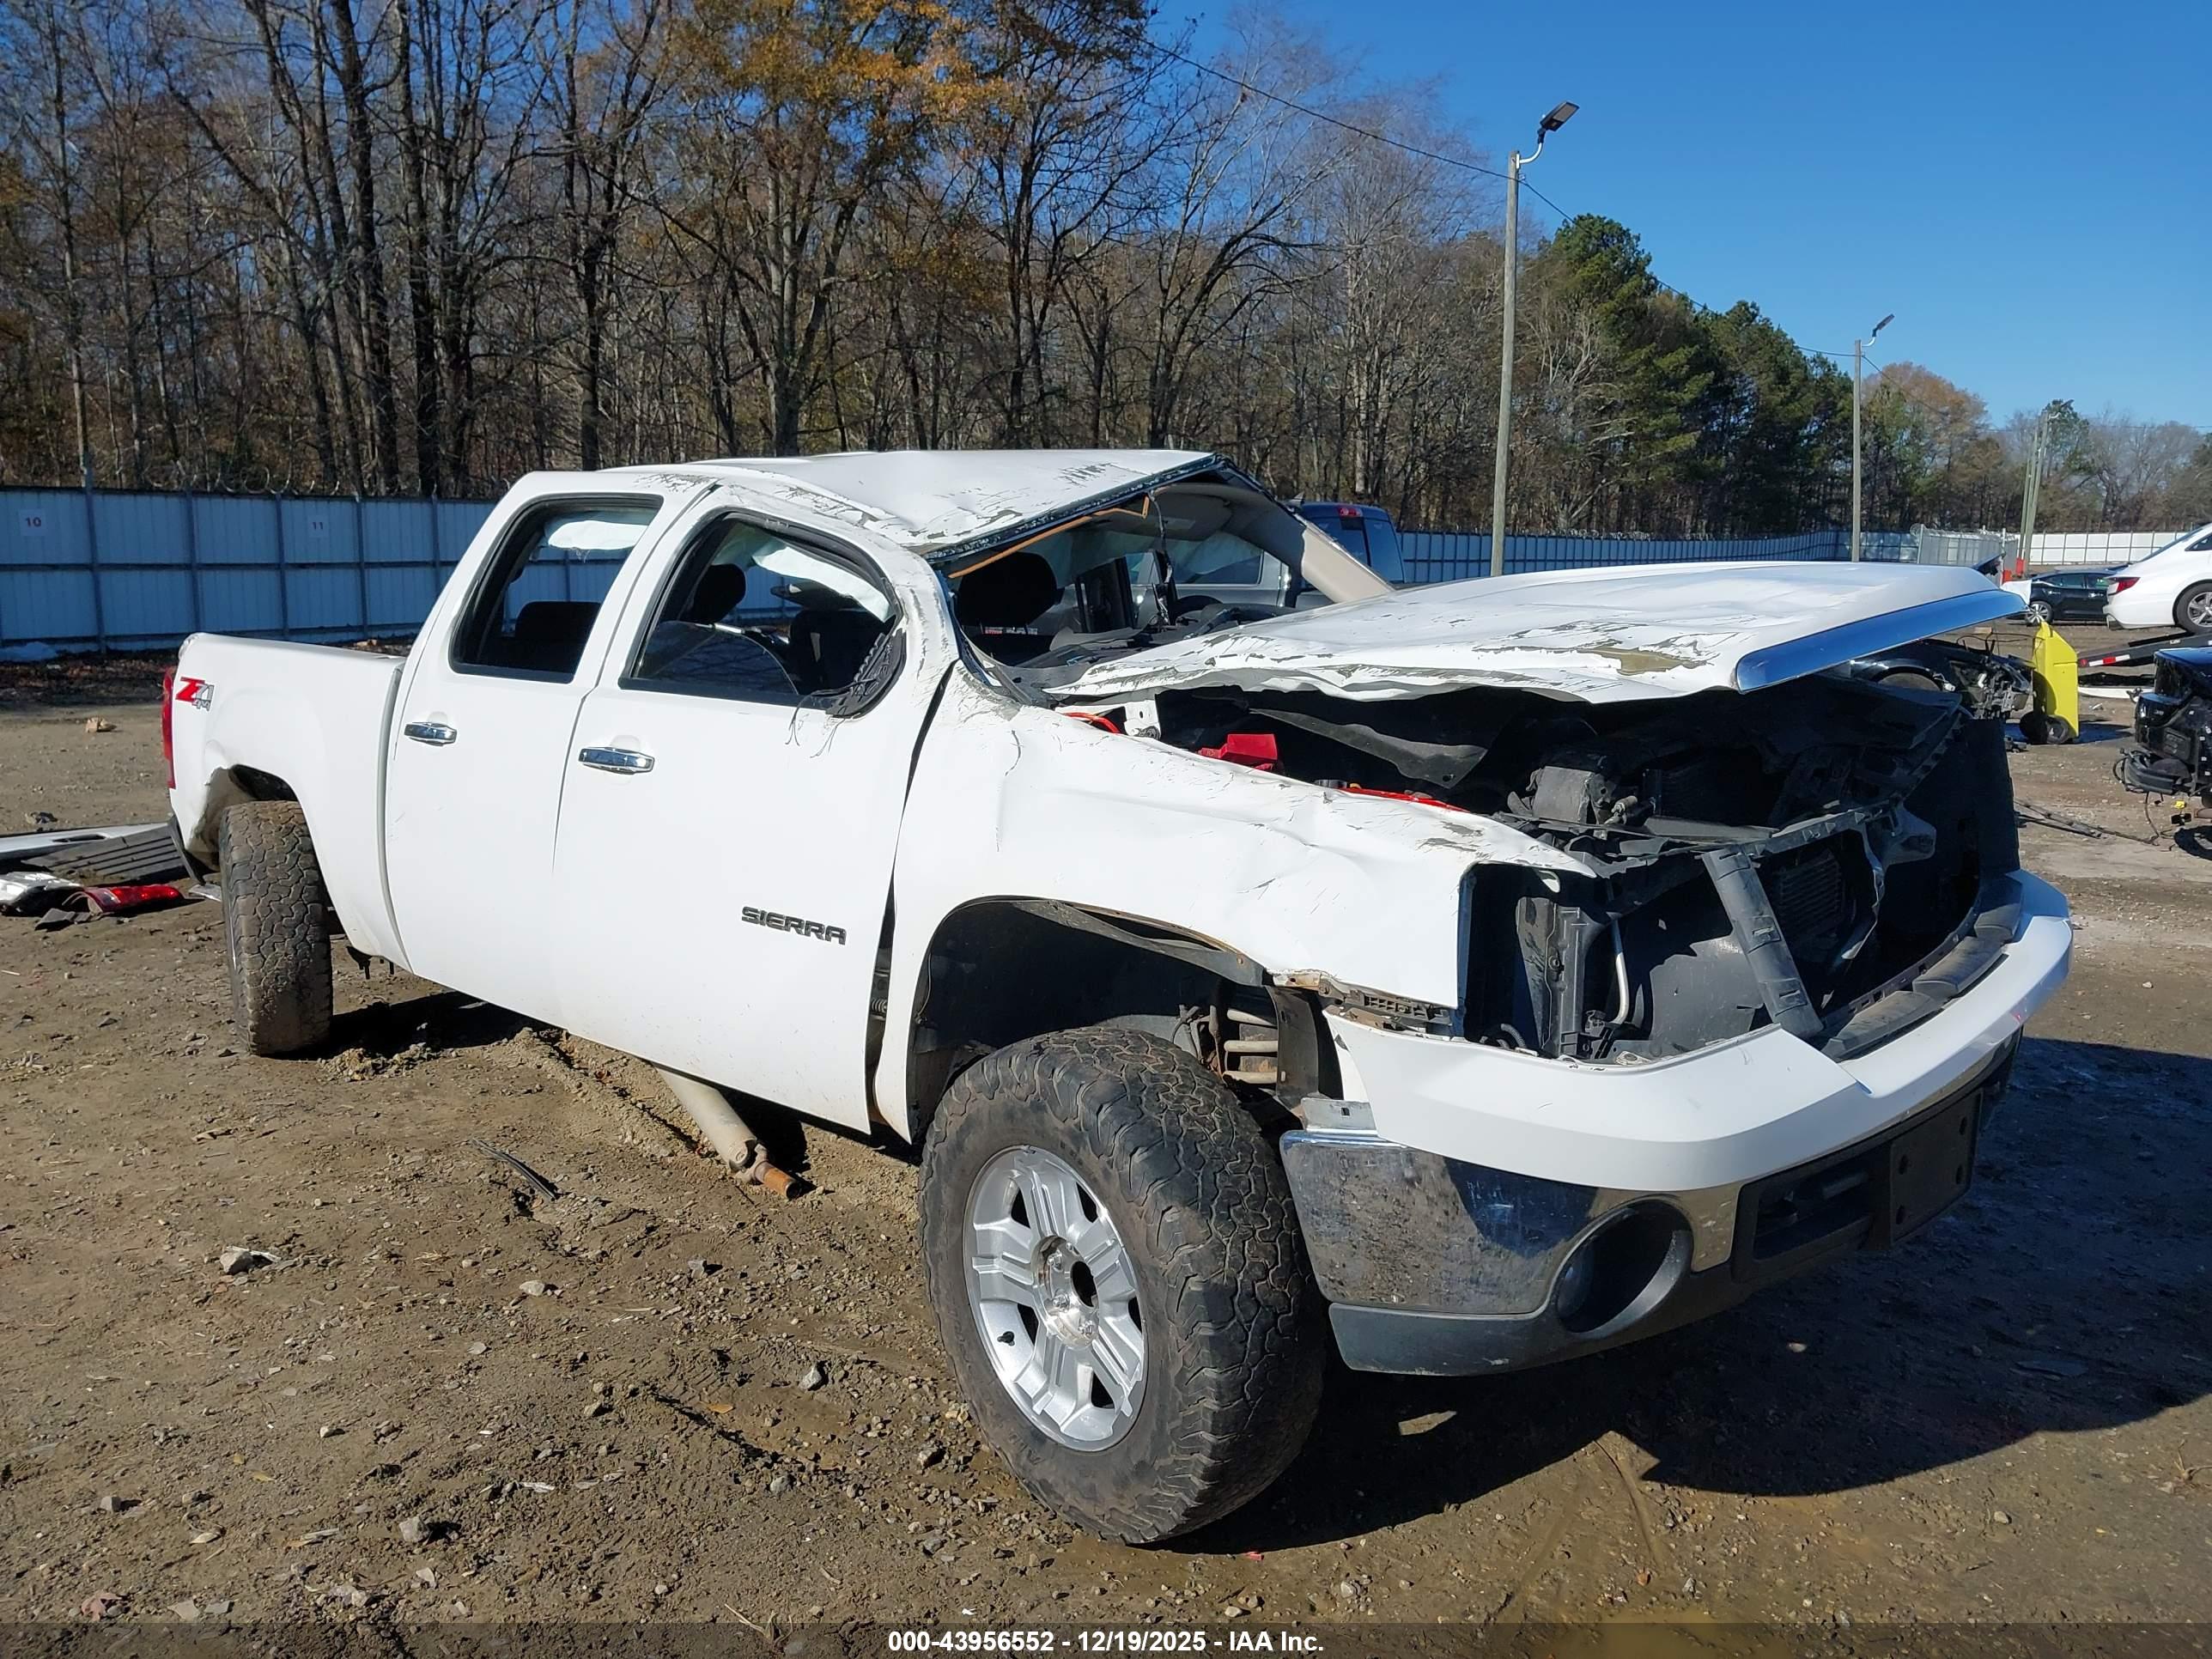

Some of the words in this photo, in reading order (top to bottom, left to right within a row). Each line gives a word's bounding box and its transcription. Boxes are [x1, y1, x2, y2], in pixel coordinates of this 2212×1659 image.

[24, 516, 42, 528] 10
[312, 520, 325, 532] 11
[741, 905, 847, 945] SIERRA
